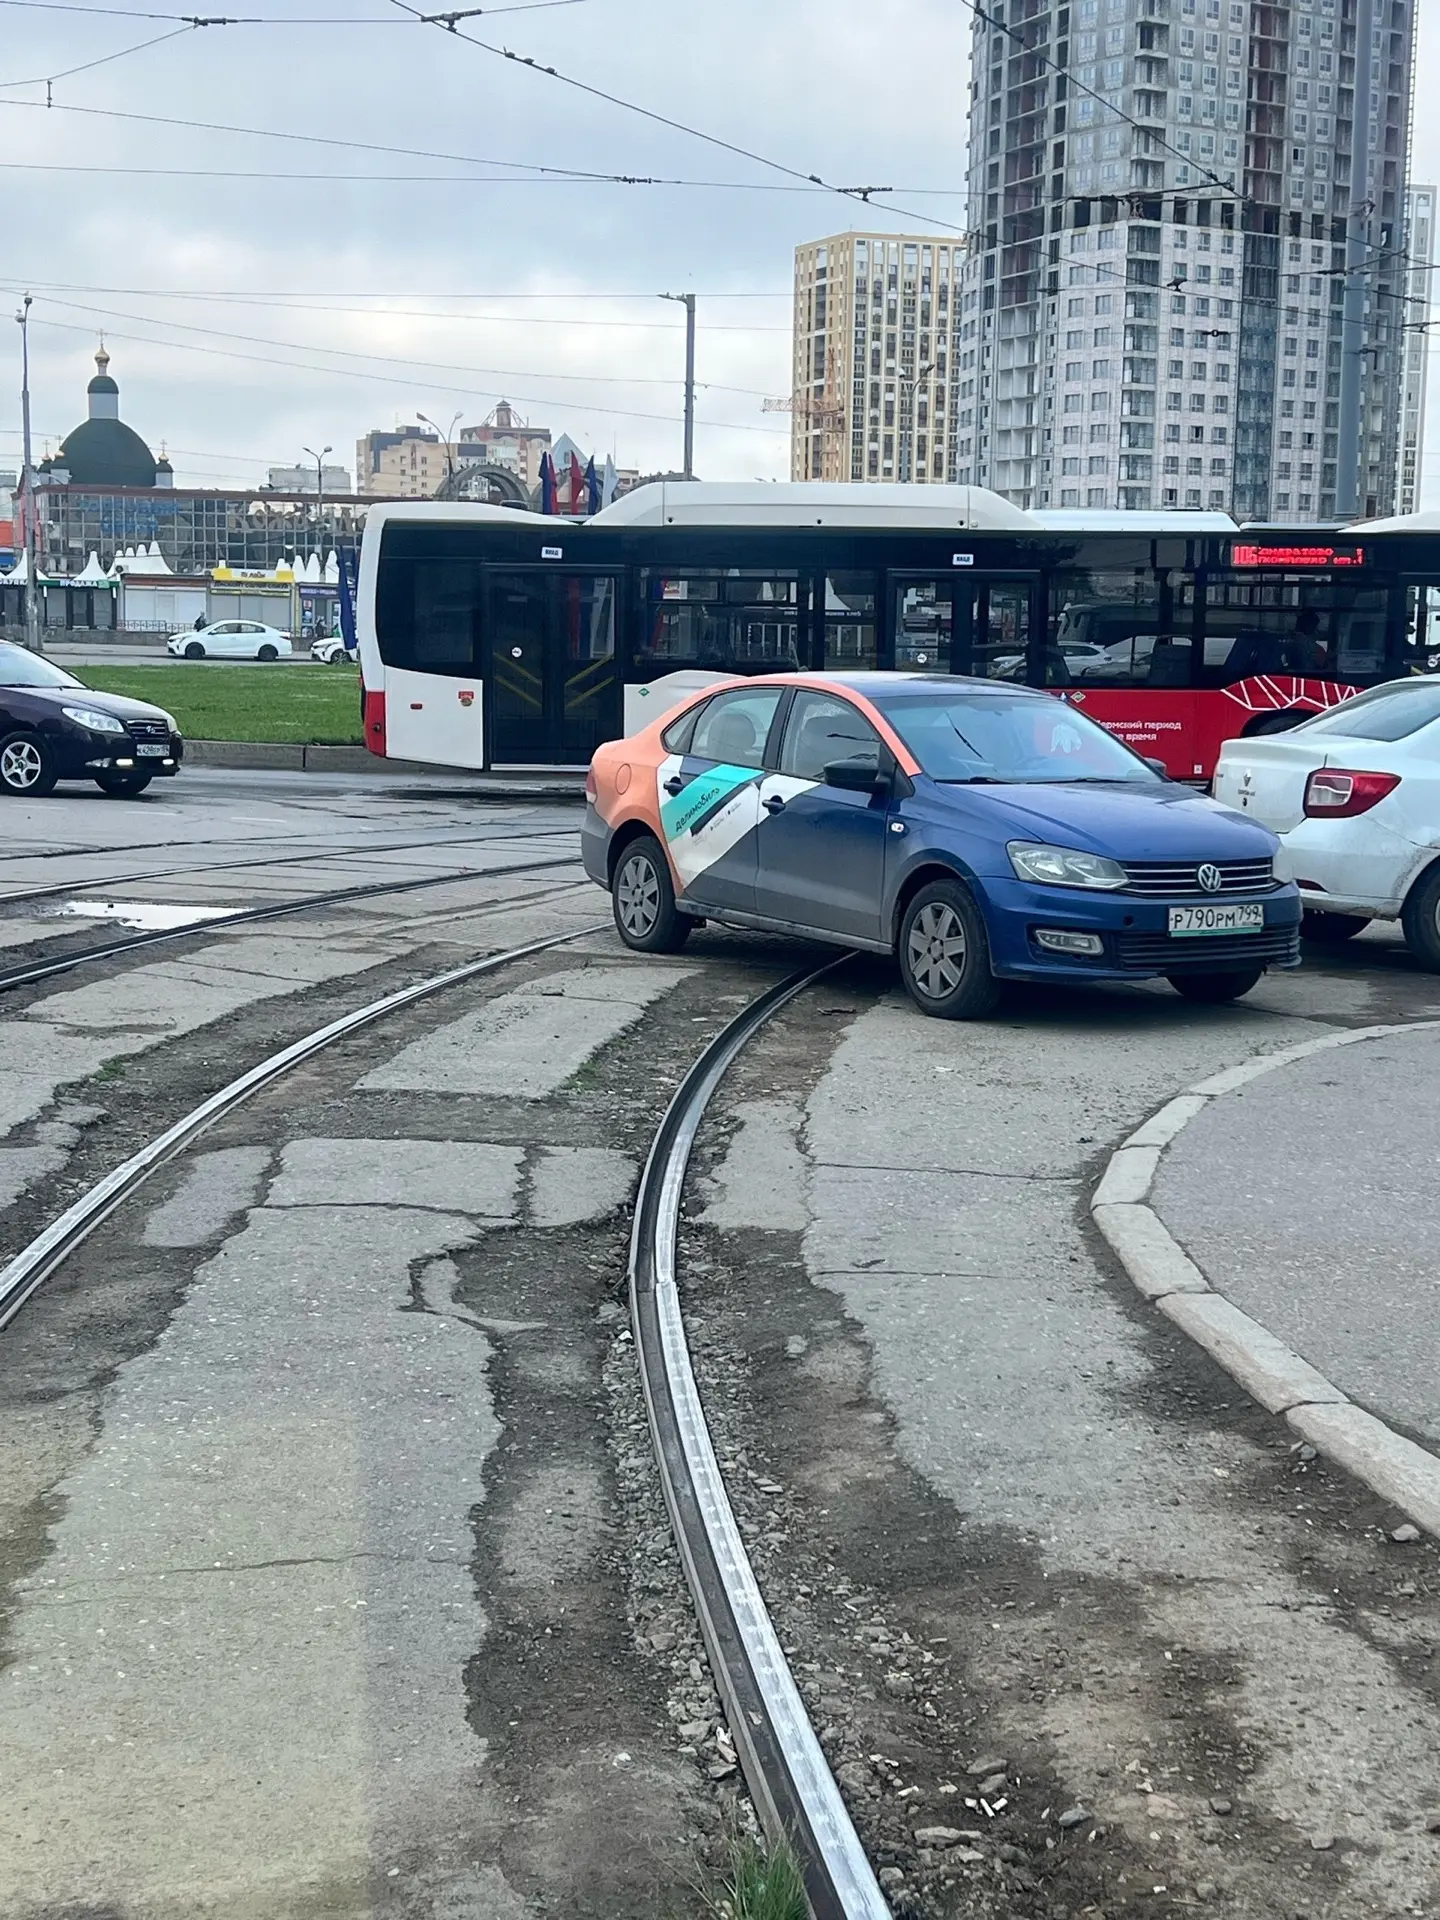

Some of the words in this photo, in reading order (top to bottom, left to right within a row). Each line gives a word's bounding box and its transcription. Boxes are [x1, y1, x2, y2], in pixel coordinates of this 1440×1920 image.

[60, 579, 98, 588] ПРОДАЖА
[1144, 721, 1182, 731] период
[1125, 733, 1157, 743] время
[1174, 909, 1236, 929] Р790РМ
[1238, 905, 1260, 921] 799
